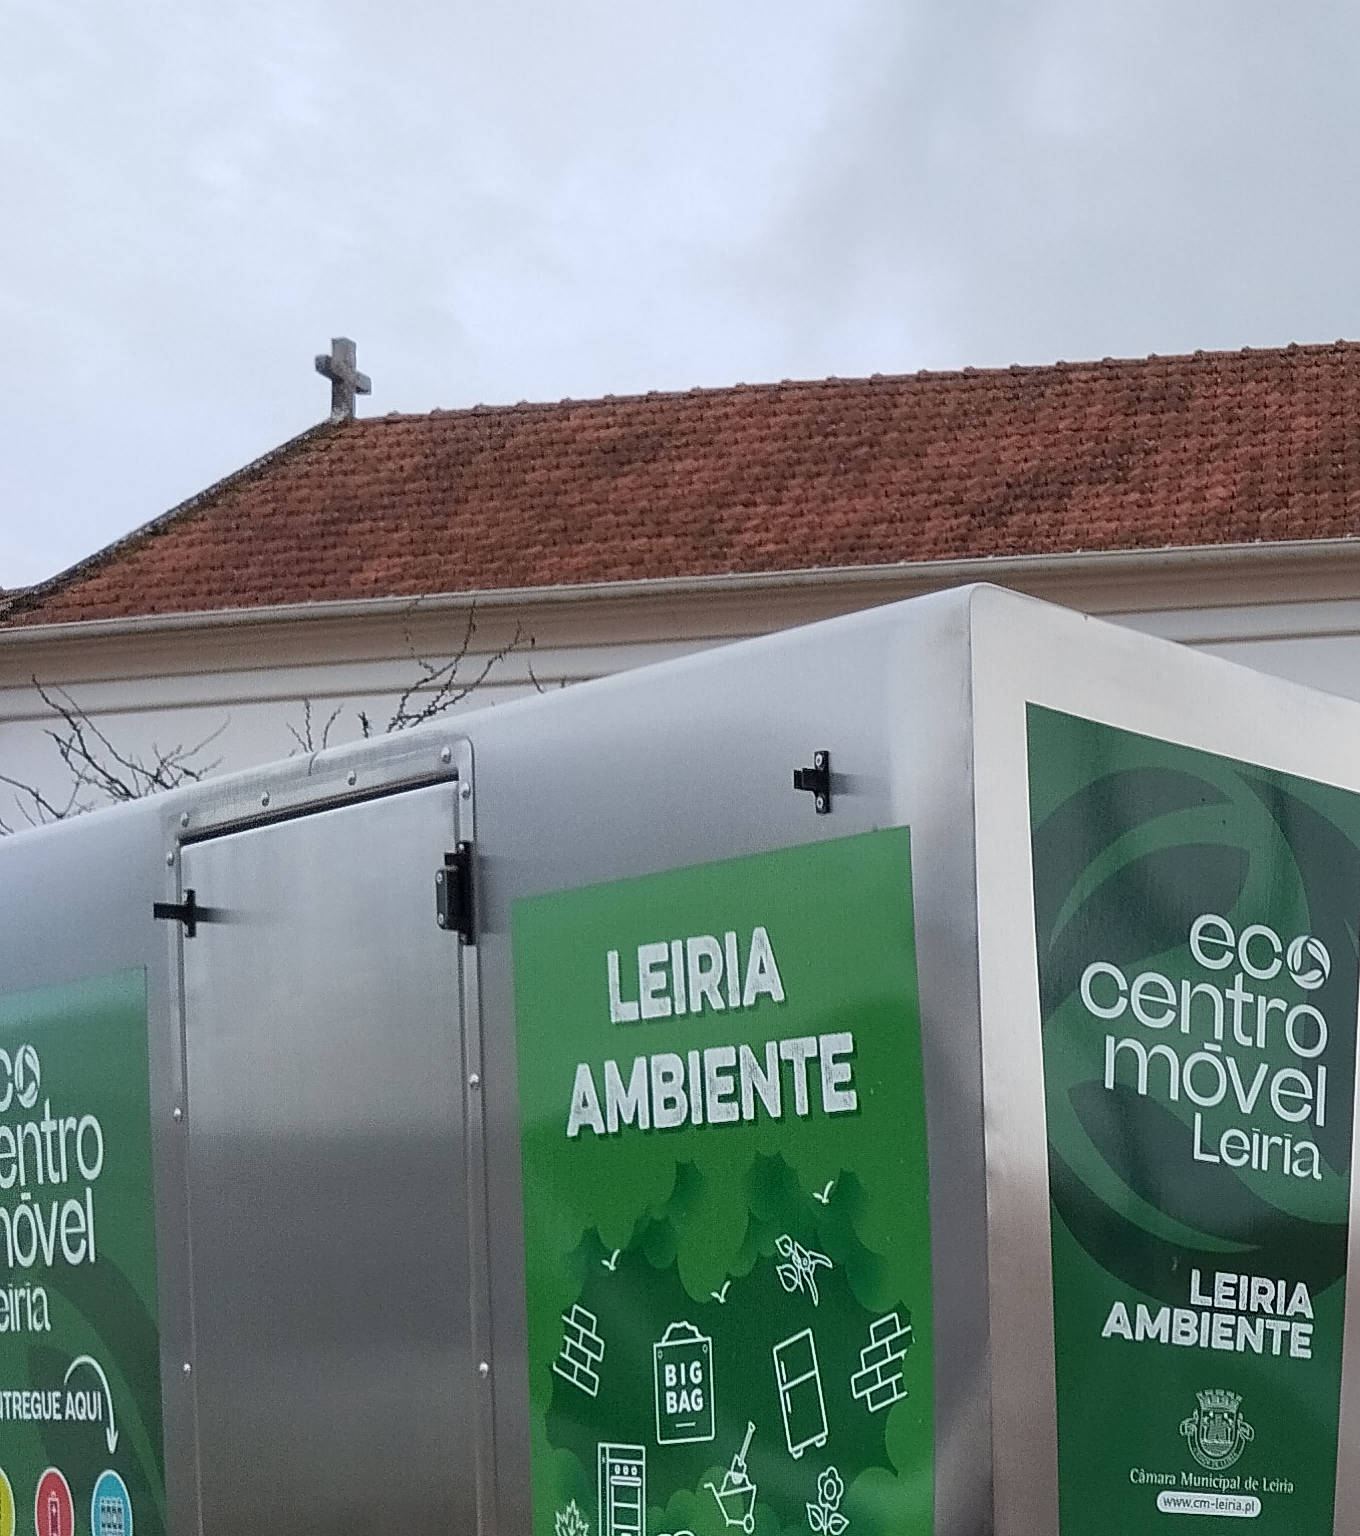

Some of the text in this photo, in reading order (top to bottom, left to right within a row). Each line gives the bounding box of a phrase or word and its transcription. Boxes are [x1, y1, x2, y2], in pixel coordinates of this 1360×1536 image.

[607, 927, 785, 1023] LEIRIA
[1189, 913, 1332, 990] eco
[1079, 961, 1329, 1058] centro
[566, 1031, 858, 1137] AMBIENTE
[1192, 1112, 1323, 1181] Leiria
[1189, 1268, 1315, 1319] LEIRIA
[1101, 1300, 1313, 1360] AMBIENTE
[664, 1360, 702, 1386] BIG
[65, 1391, 102, 1422] AQUI
[665, 1389, 703, 1413] BAG
[1129, 1467, 1295, 1495] Câmara Municipal de Leiria
[1162, 1494, 1256, 1515] www.cm-leiria.pt
